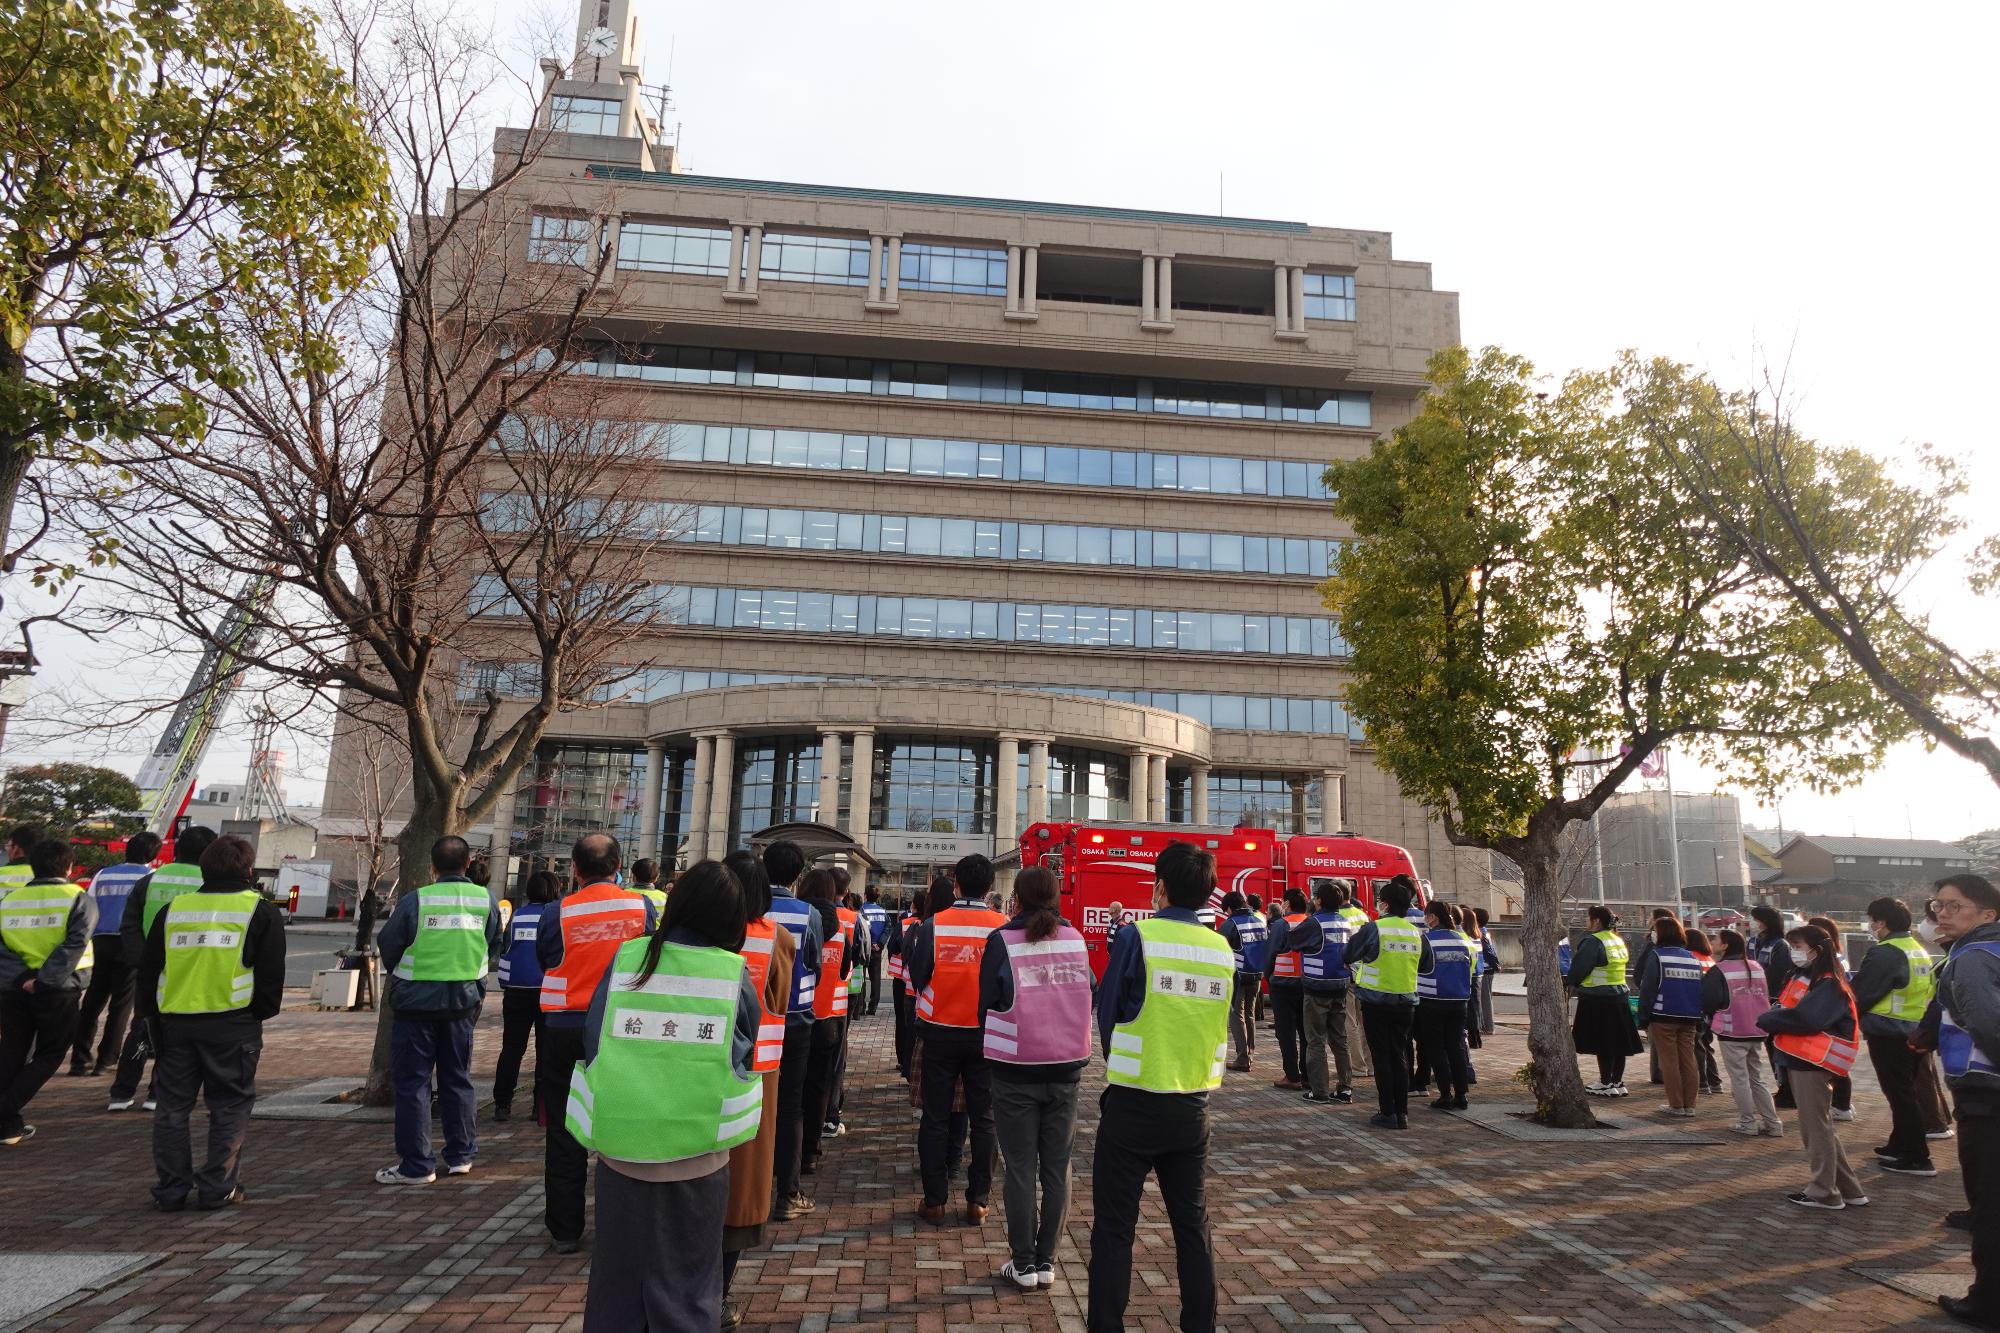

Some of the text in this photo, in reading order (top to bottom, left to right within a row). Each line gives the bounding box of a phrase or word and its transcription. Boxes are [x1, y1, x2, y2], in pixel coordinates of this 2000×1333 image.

[1129, 850, 1154, 858] OSAKA
[1304, 857, 1376, 869] SUPER RESCUE
[1086, 909, 1155, 924] RECU
[517, 929, 537, 938] 市民
[1083, 926, 1107, 934] POWE
[176, 934, 233, 946] 調査班
[1160, 975, 1222, 996] 機動班
[624, 1016, 715, 1040] 給食班
